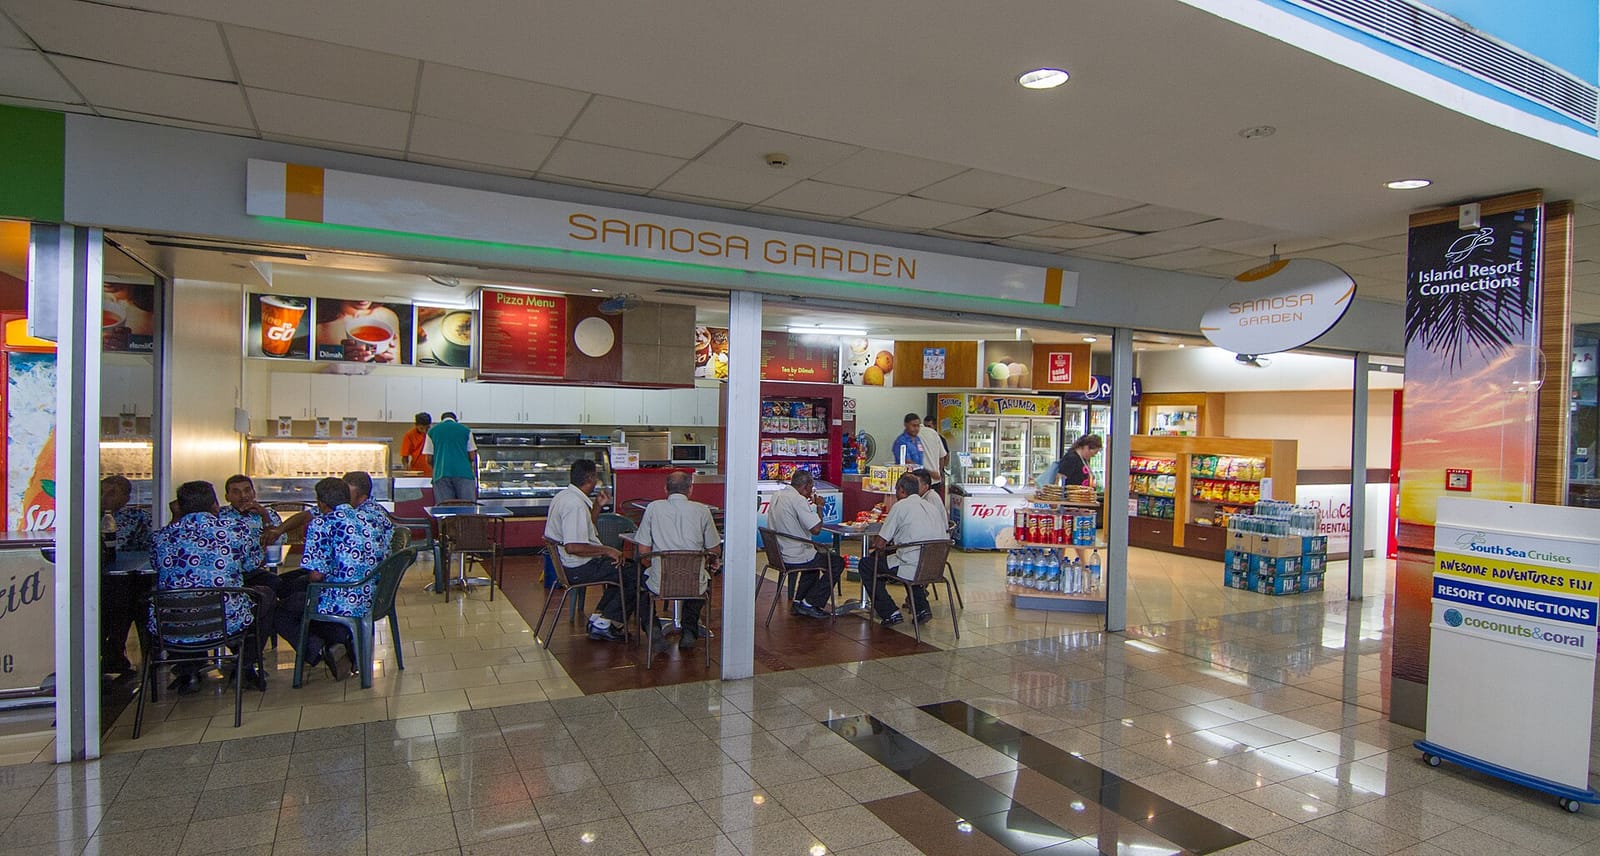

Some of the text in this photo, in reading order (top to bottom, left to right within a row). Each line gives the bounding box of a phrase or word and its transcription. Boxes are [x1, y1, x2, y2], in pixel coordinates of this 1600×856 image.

[568, 213, 916, 280] SAMOSA GARDEN
[1418, 260, 1523, 284] Island Resort
[1420, 276, 1520, 296] Connections
[497, 292, 556, 308] Pizza Menu
[1228, 293, 1314, 315] SAMOSA
[1239, 312, 1303, 327] GARDEN
[268, 326, 296, 341] GO
[320, 350, 343, 358] Dilmah
[993, 398, 1036, 413] TARUMBA
[24, 504, 56, 532] Sp
[971, 504, 994, 519] Tip
[1321, 522, 1350, 533] RENTAL
[1469, 542, 1572, 564] South Sea Cruises
[1440, 560, 1592, 591] AWESOME ADVENTURES FIJI
[1438, 585, 1590, 620] RESORT CONNECTIONS
[1464, 616, 1584, 648] coconuts&coral
